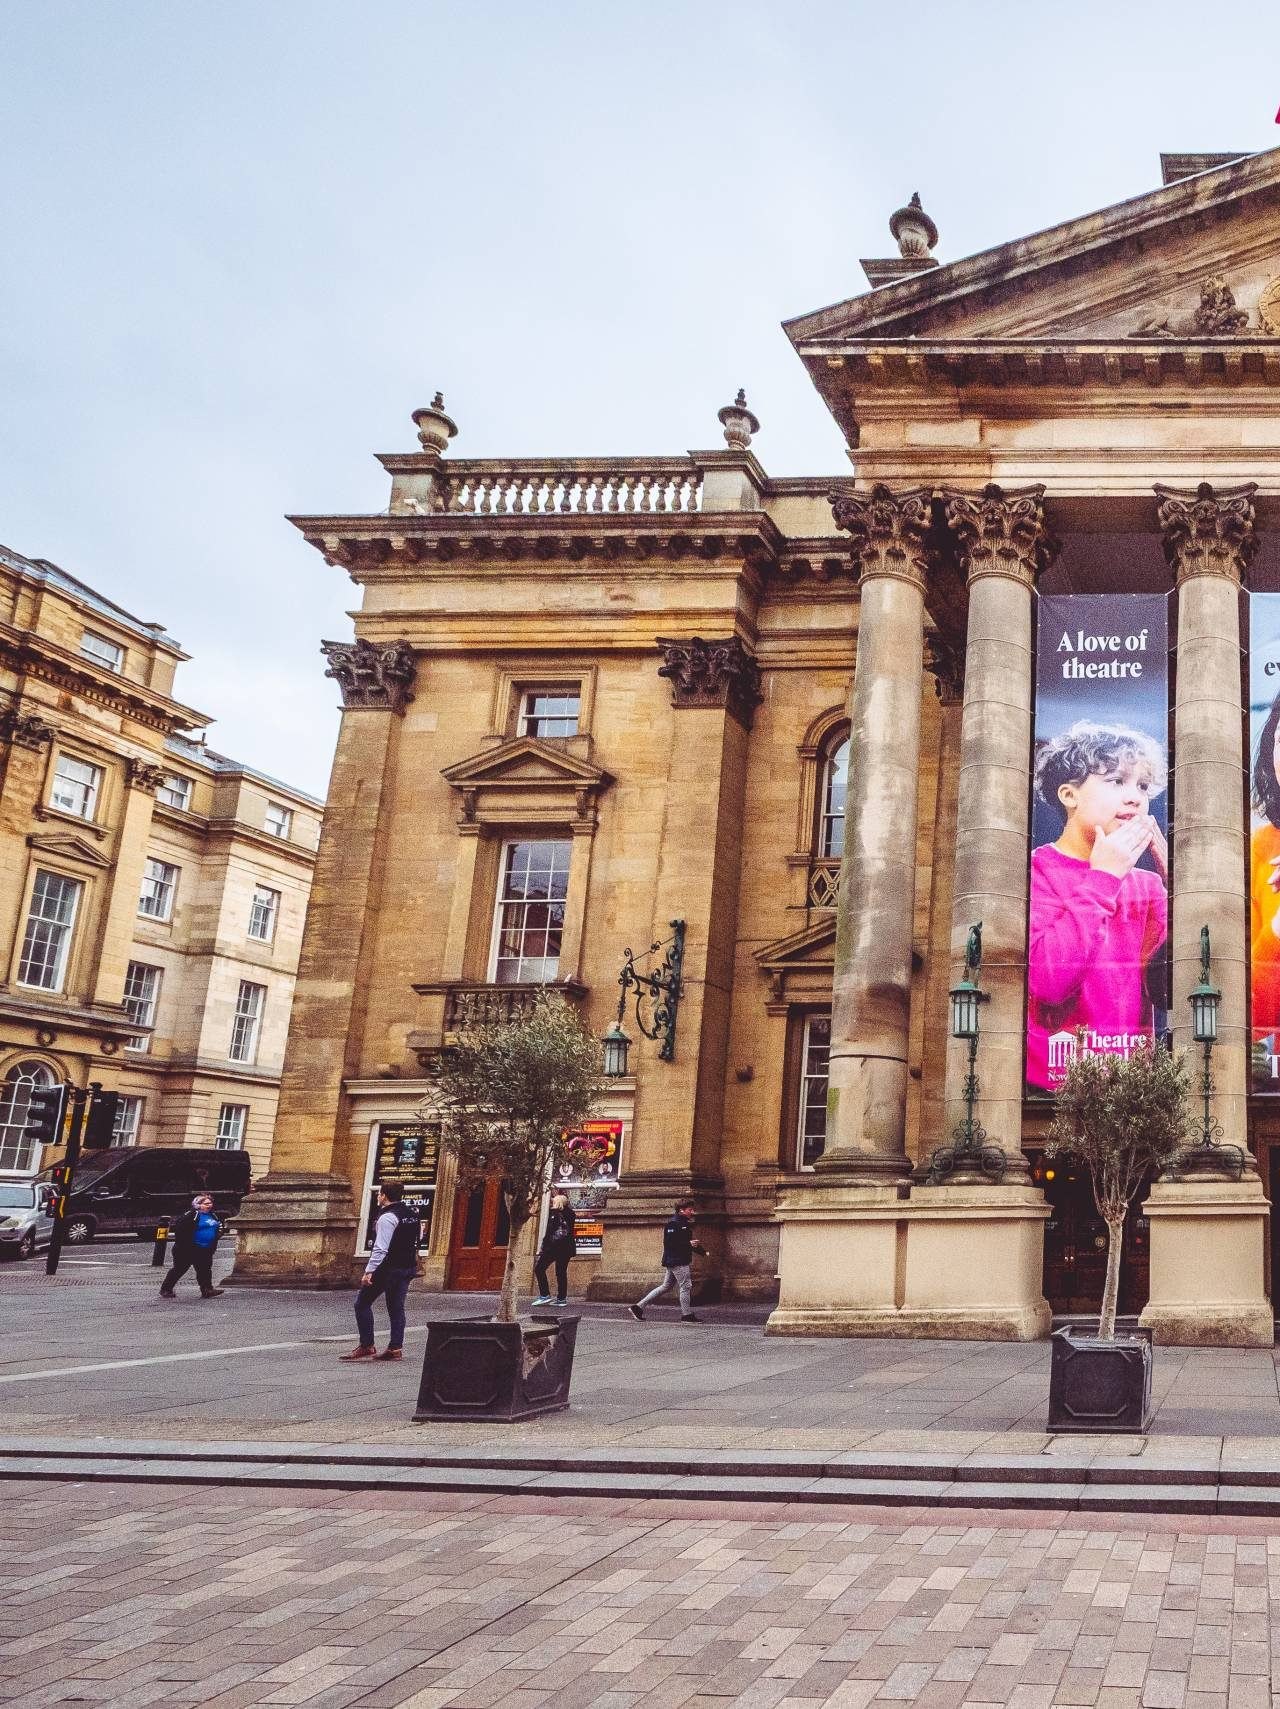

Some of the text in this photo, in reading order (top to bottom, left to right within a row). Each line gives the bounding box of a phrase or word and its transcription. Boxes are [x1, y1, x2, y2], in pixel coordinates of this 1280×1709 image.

[1056, 628, 1149, 652] A love of
[1062, 656, 1143, 679] theatre
[1082, 1029, 1147, 1049] Theatre
